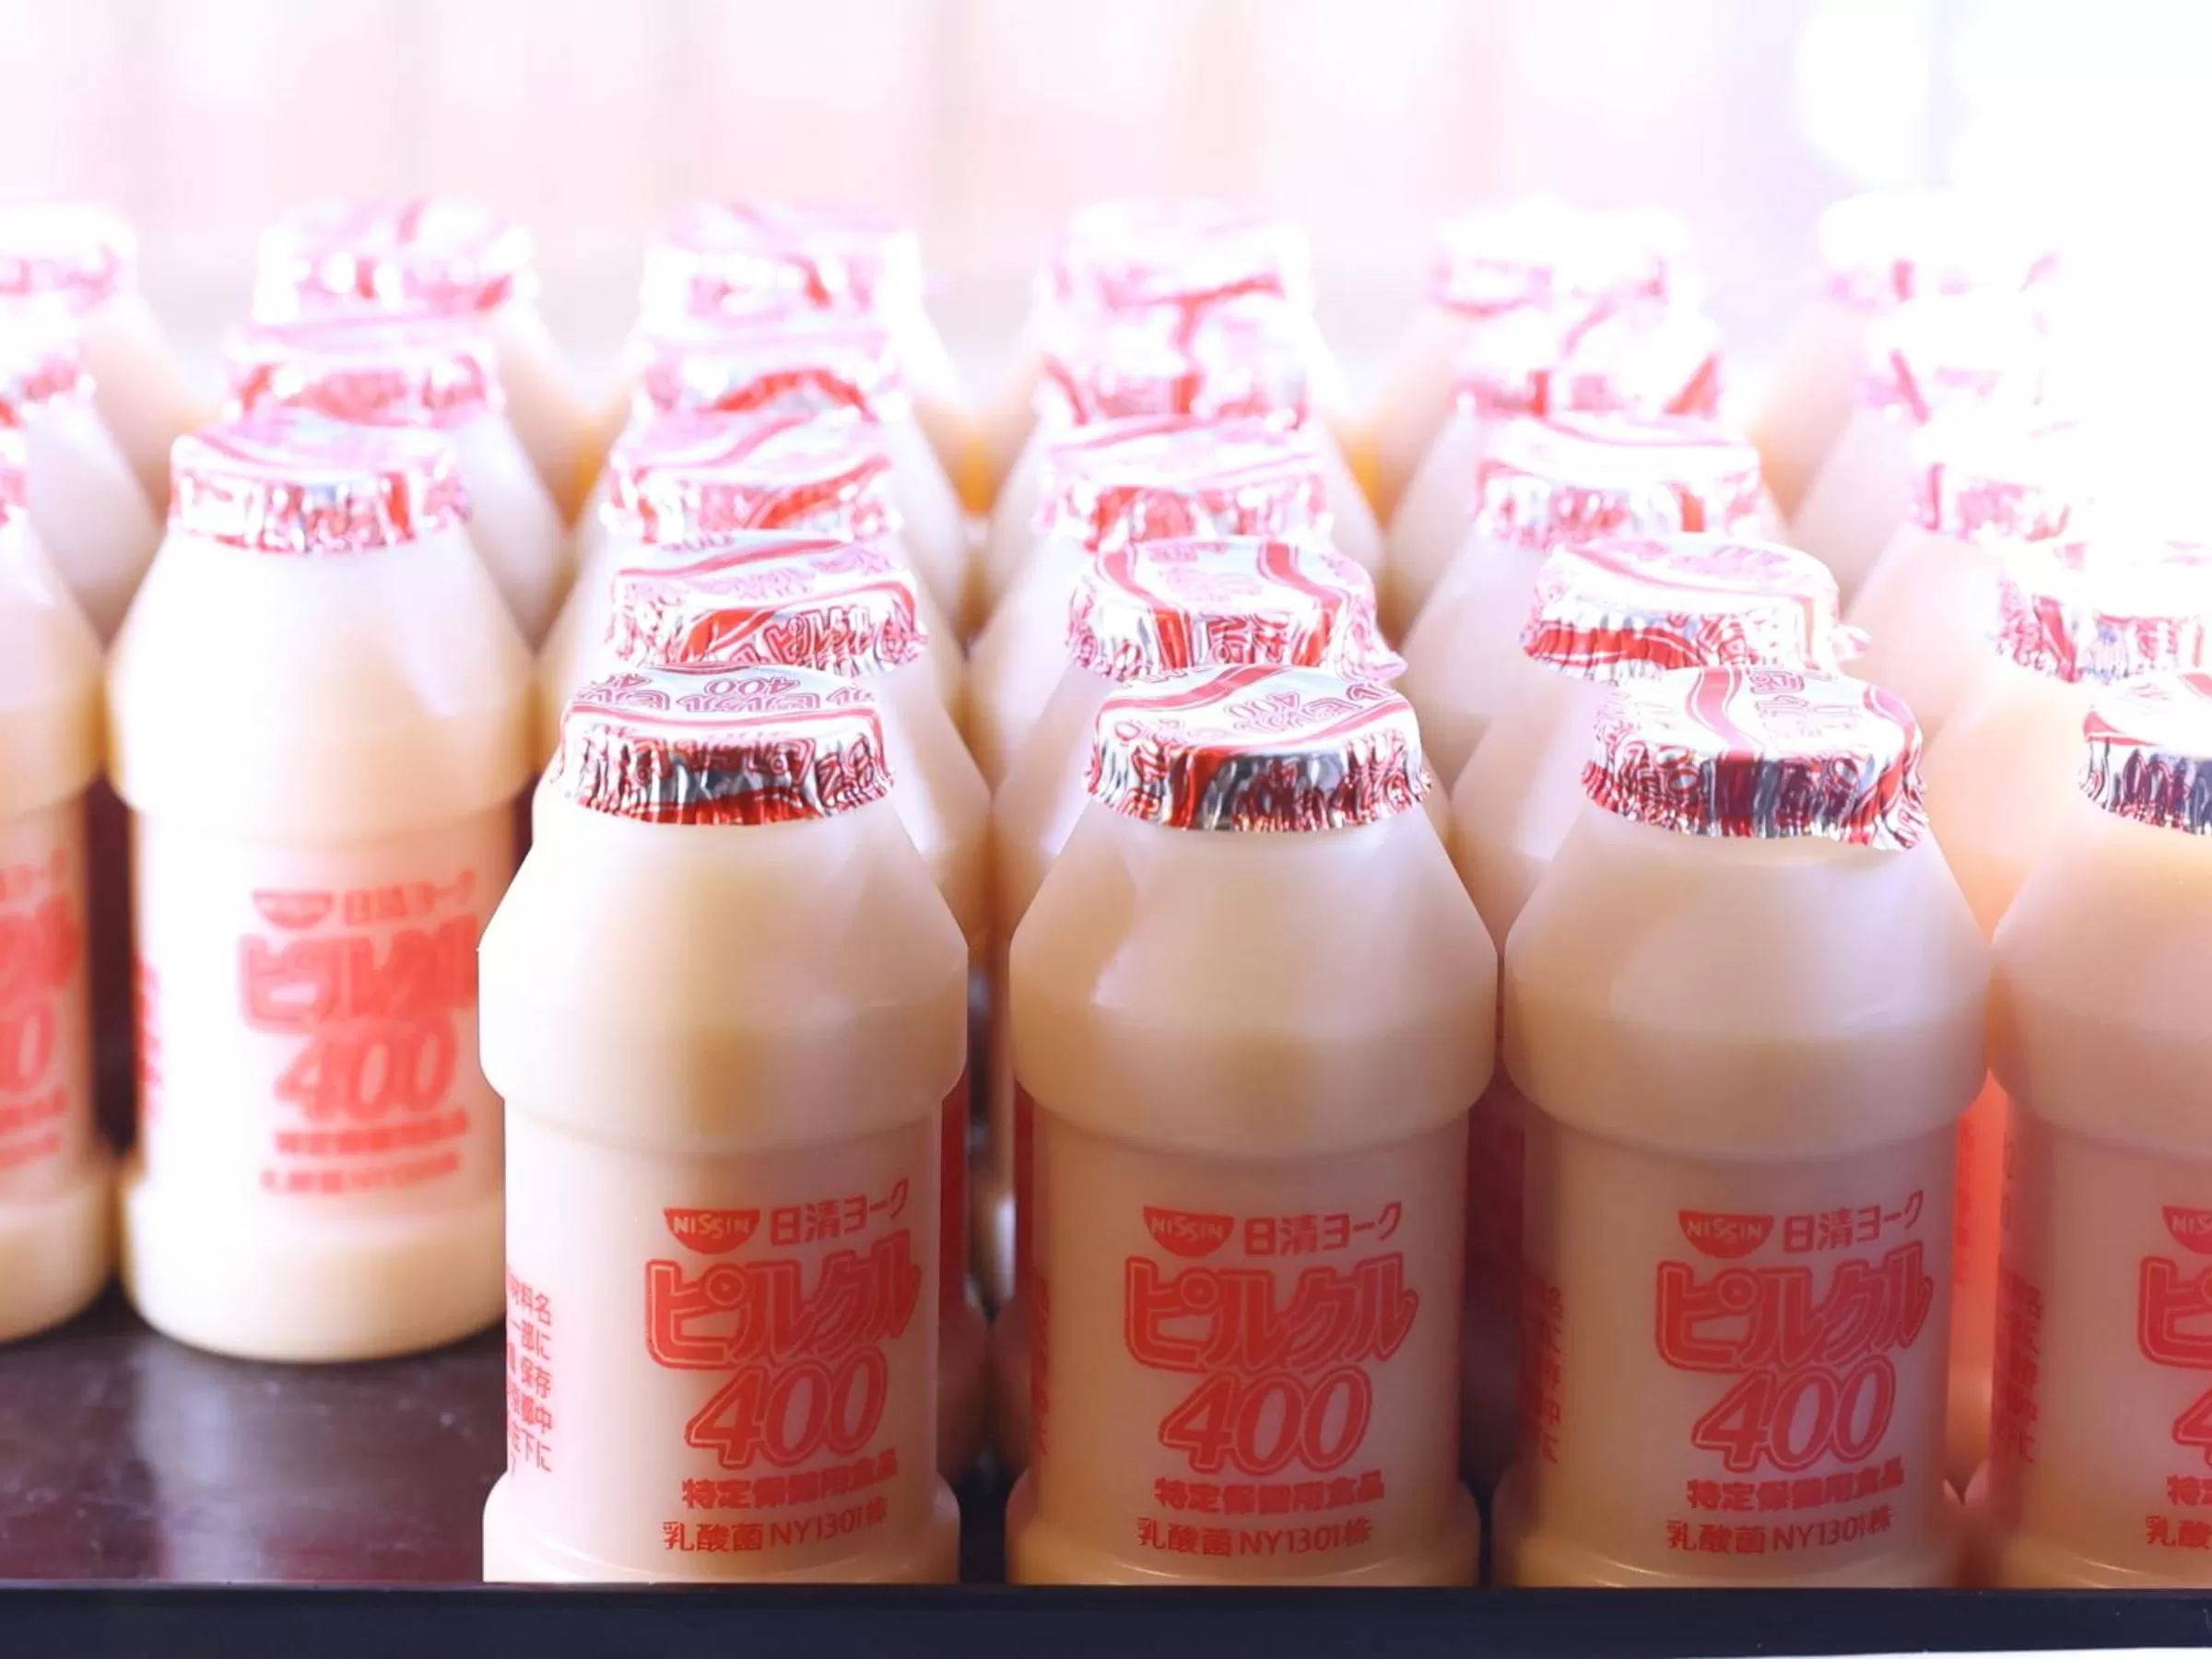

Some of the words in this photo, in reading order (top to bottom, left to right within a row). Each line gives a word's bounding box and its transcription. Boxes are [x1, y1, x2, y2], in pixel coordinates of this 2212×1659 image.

[274, 1017, 457, 1120] 400
[674, 1212, 749, 1239] NISSIN
[771, 1179, 908, 1246] 日清ヨーク
[1151, 1214, 1223, 1241] NISSIN
[1245, 1201, 1401, 1255] 日清ヨーク
[1687, 1216, 1762, 1242] NISSIN
[1783, 1189, 1924, 1253] 日清ヨーク
[645, 1229, 920, 1370] ピルクル
[1124, 1252, 1418, 1374] ピルクル
[1656, 1241, 1934, 1373] ピルクル
[684, 1346, 888, 1470] 400
[1158, 1365, 1373, 1475] 400
[1691, 1353, 1897, 1473] 400
